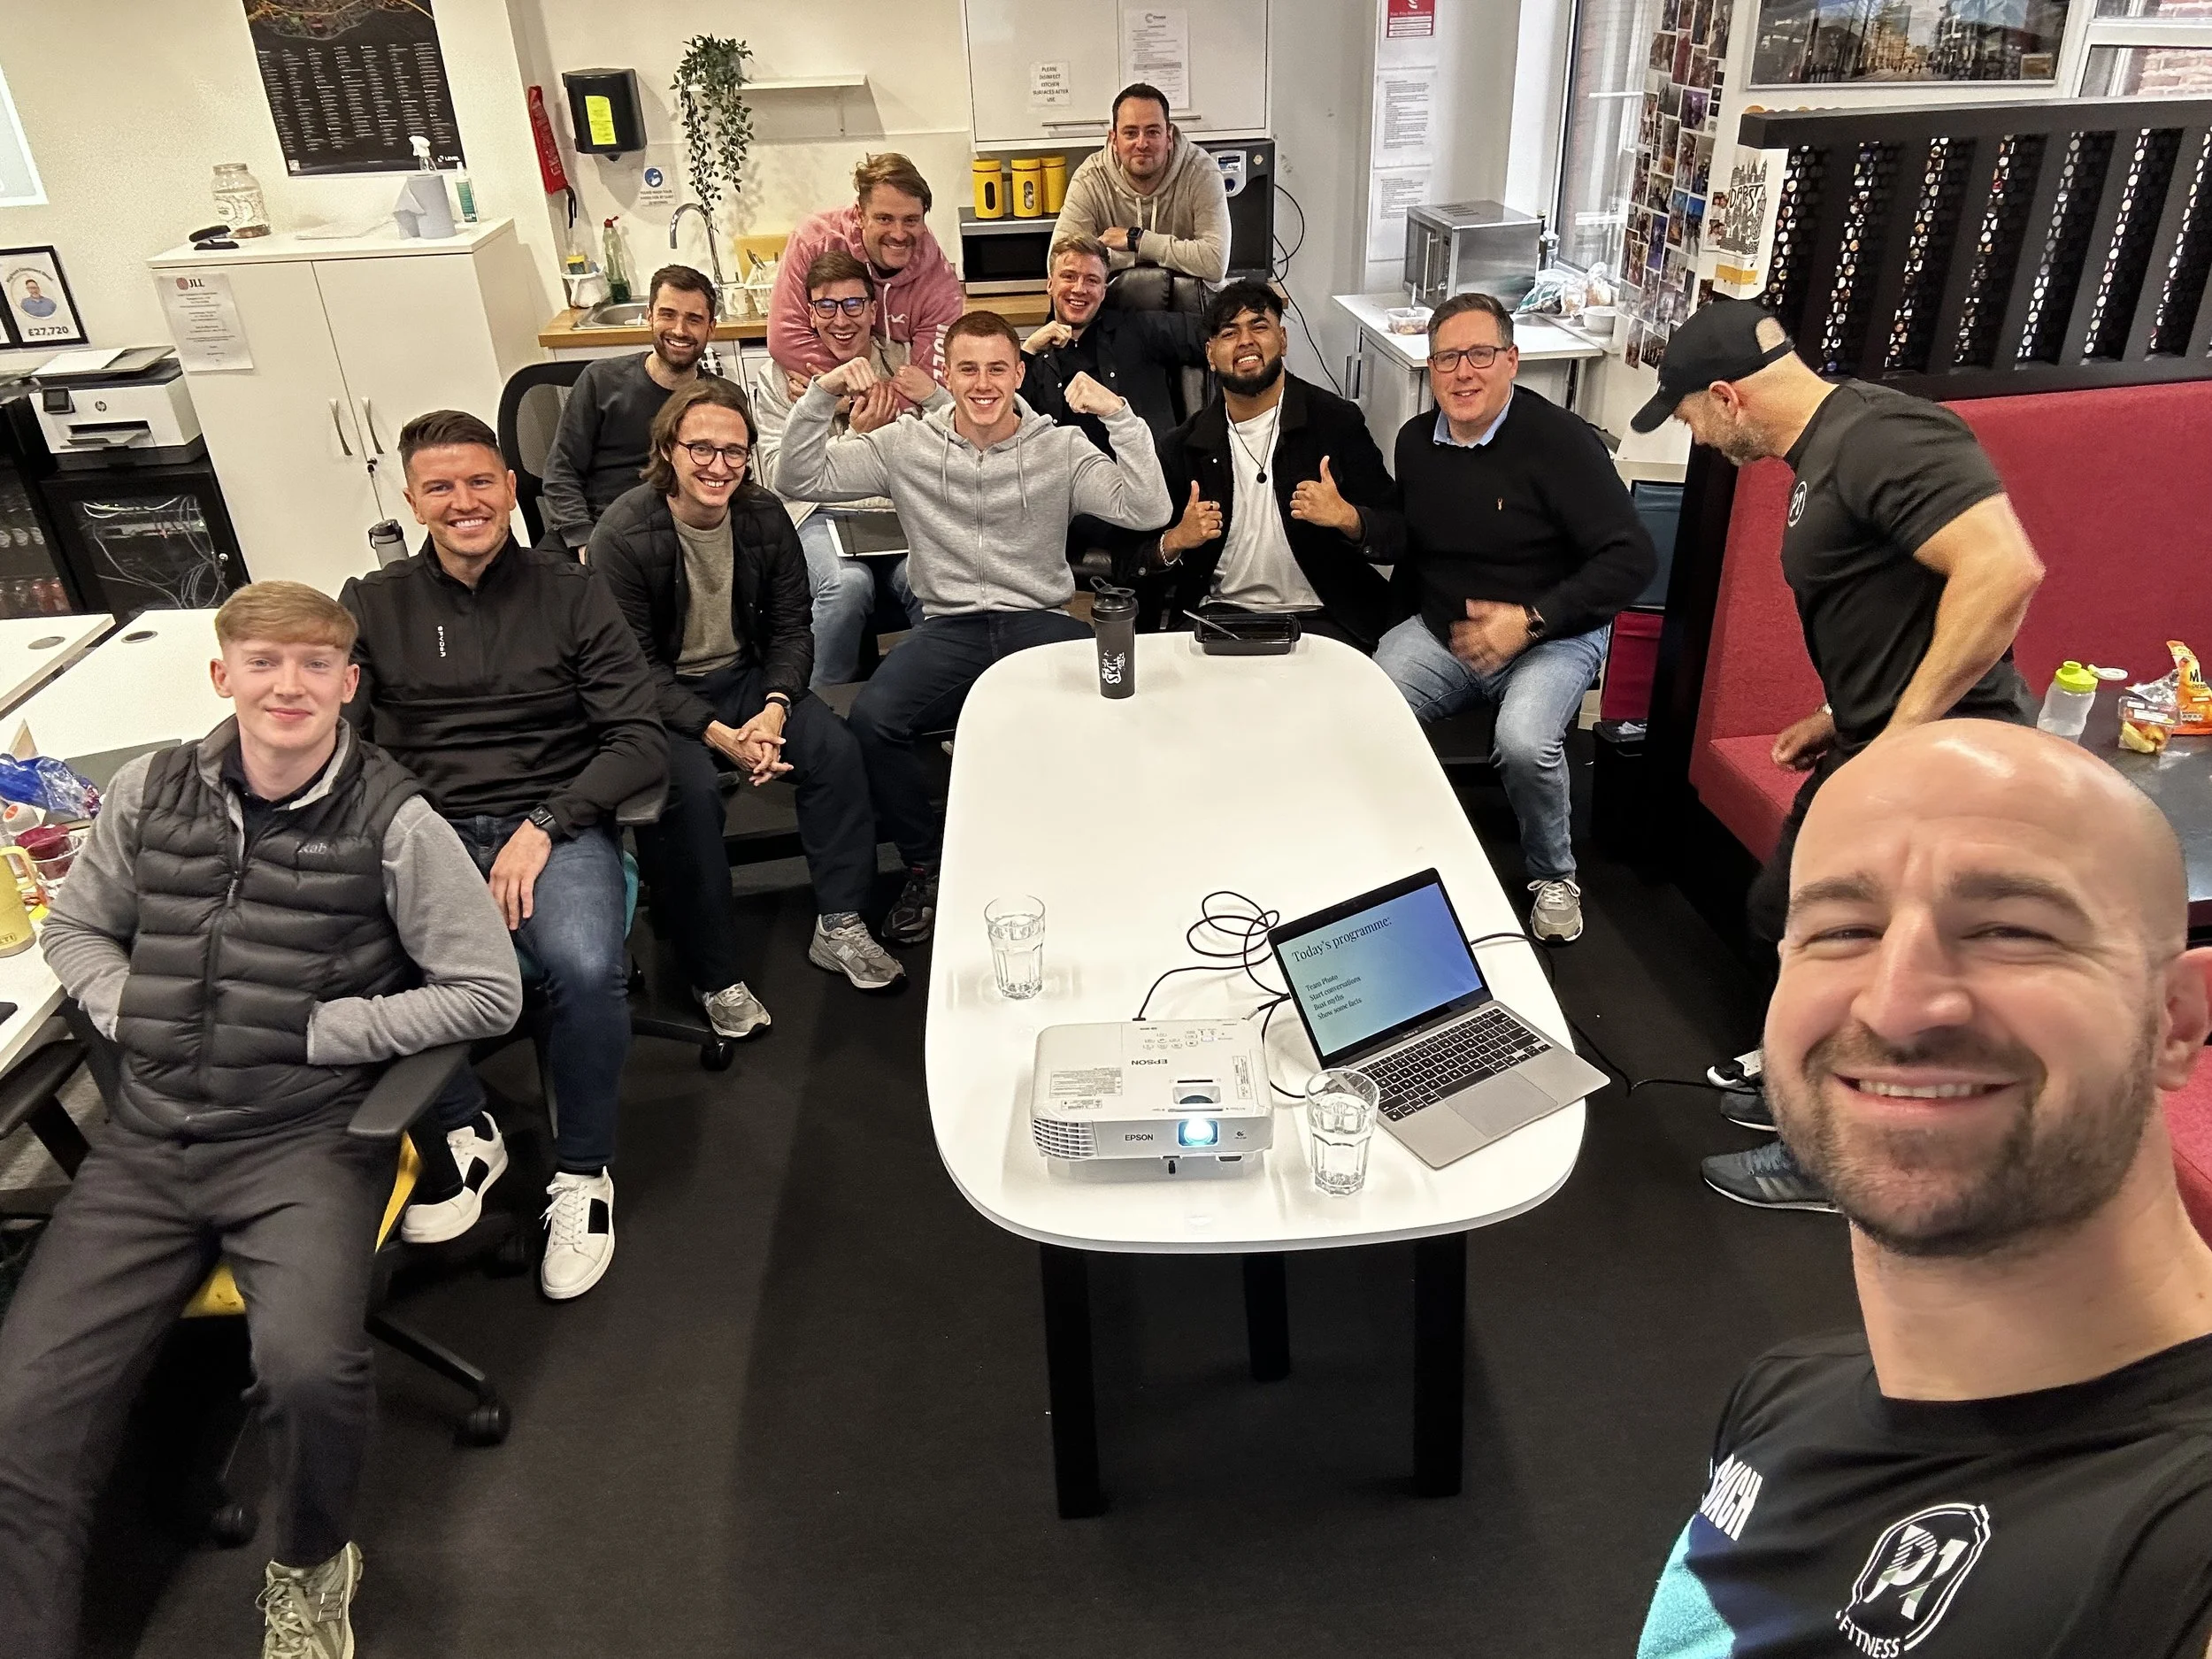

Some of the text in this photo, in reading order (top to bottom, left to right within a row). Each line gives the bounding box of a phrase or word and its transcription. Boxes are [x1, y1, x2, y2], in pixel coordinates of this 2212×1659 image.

[188, 279, 205, 288] JLL
[1292, 917, 1392, 962] Today's programme:
[1305, 974, 1338, 992] Team Photo
[1310, 976, 1362, 1002] Start conversations
[1313, 994, 1345, 1010] Bust myths
[1317, 997, 1363, 1020] Show some facts
[1839, 1614, 1901, 1659] FITNESS
